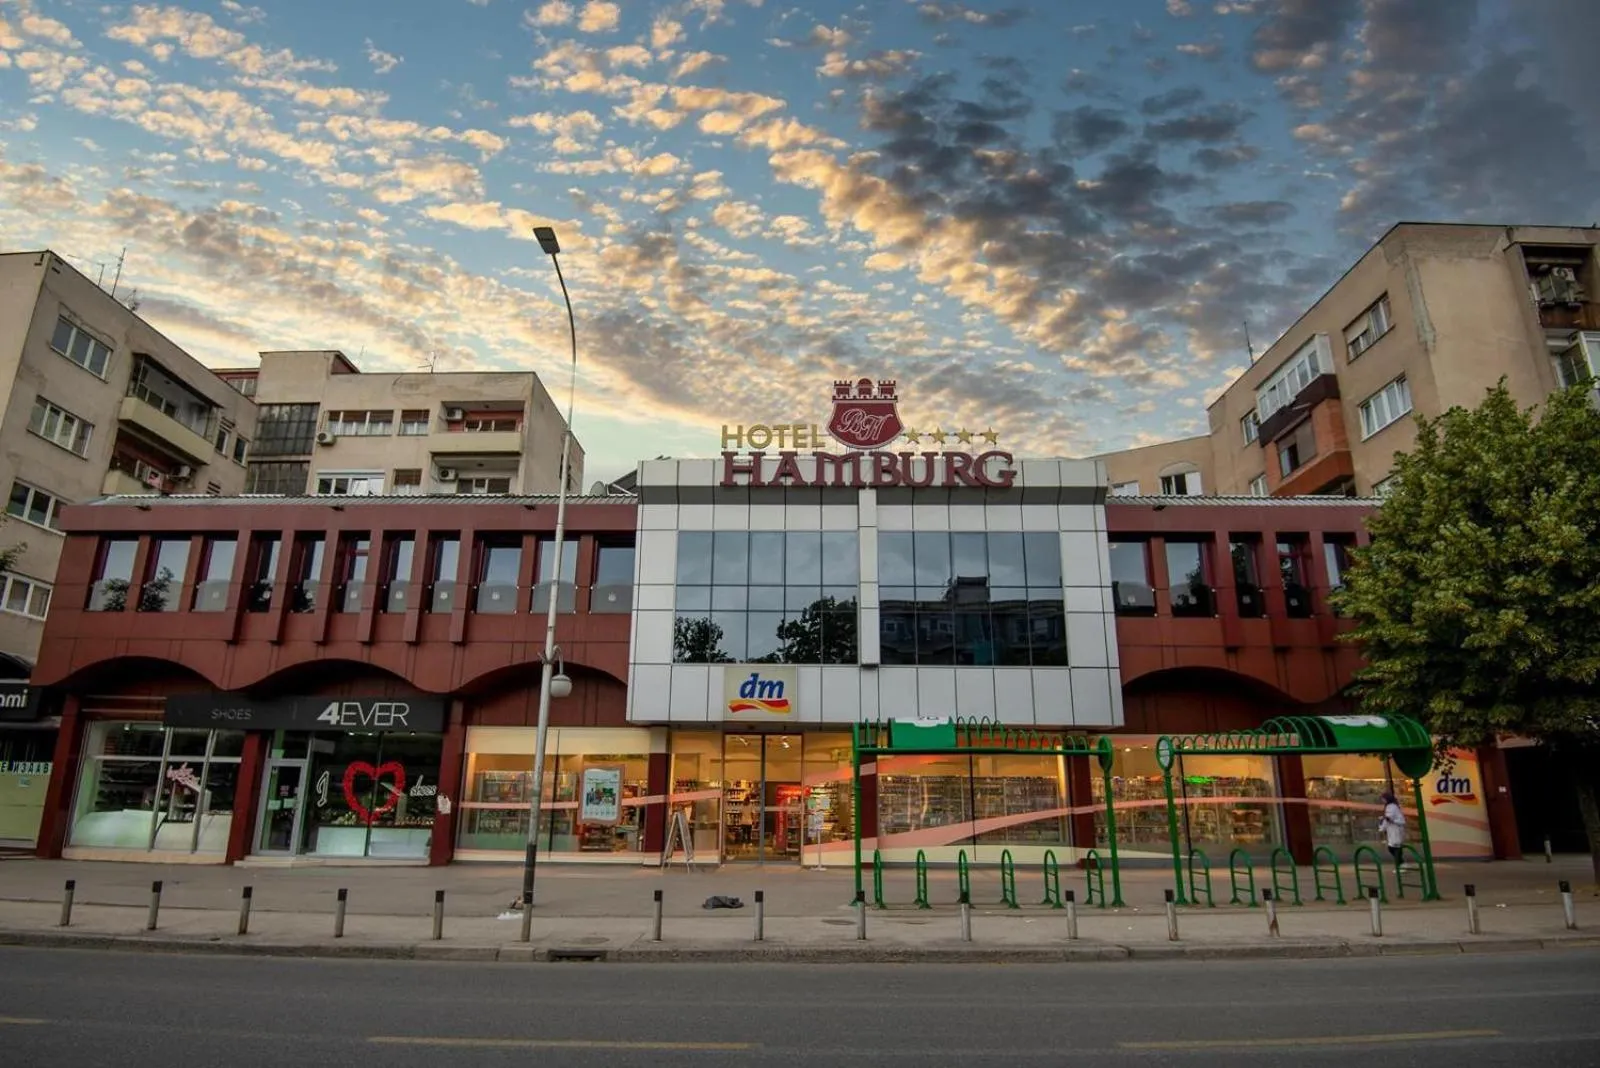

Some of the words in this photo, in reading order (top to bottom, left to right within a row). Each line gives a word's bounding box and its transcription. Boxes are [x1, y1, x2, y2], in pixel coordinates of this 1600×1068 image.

[721, 424, 826, 449] HOTEL
[720, 451, 1018, 488] HAMBURG
[739, 672, 785, 699] dm
[211, 708, 253, 720] SHOES
[316, 701, 409, 727] 4EVER
[1436, 773, 1471, 794] dm
